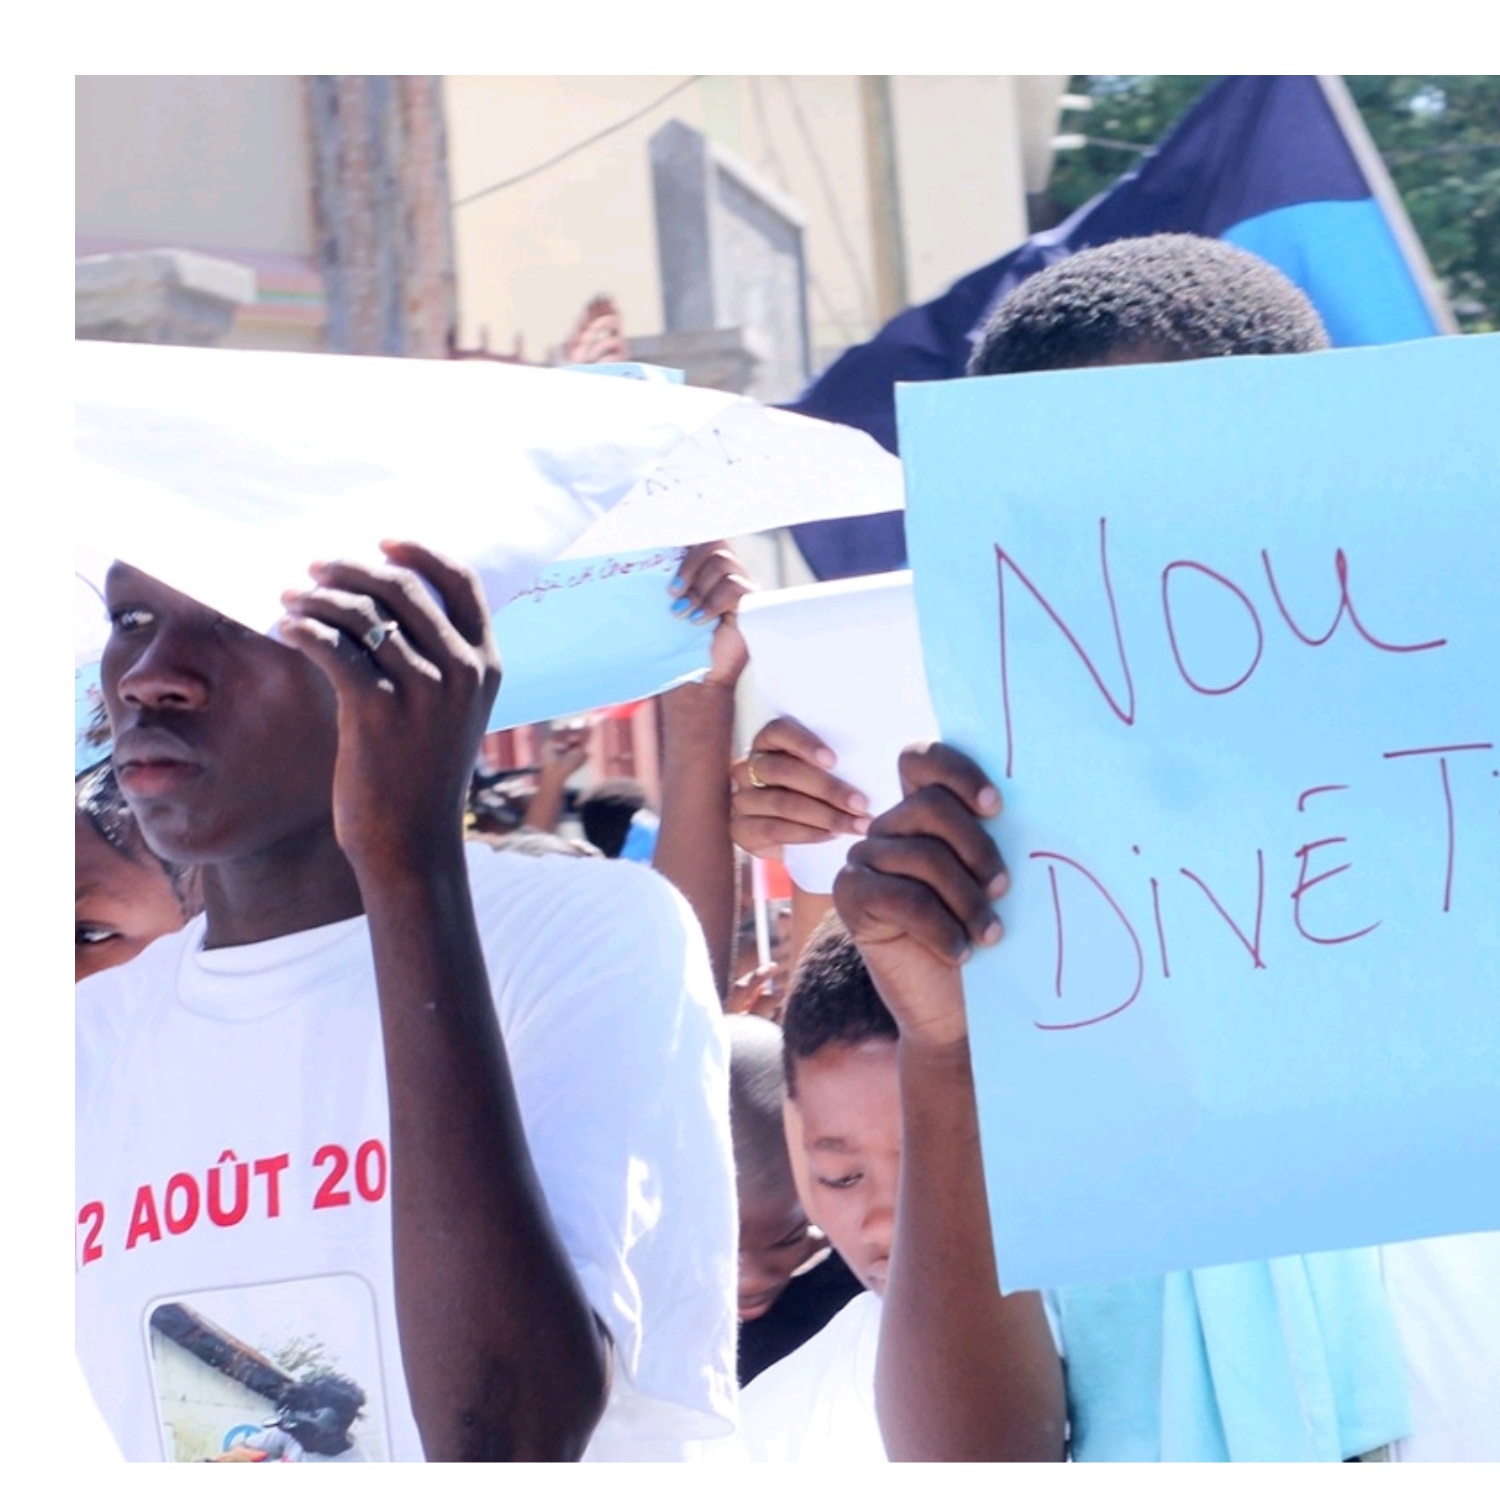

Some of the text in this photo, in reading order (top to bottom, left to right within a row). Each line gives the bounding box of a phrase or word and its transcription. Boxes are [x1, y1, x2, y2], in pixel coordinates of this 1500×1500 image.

[994, 516, 1447, 778] NOU
[75, 1200, 106, 1272] 2
[124, 1149, 290, 1250] AOÛT
